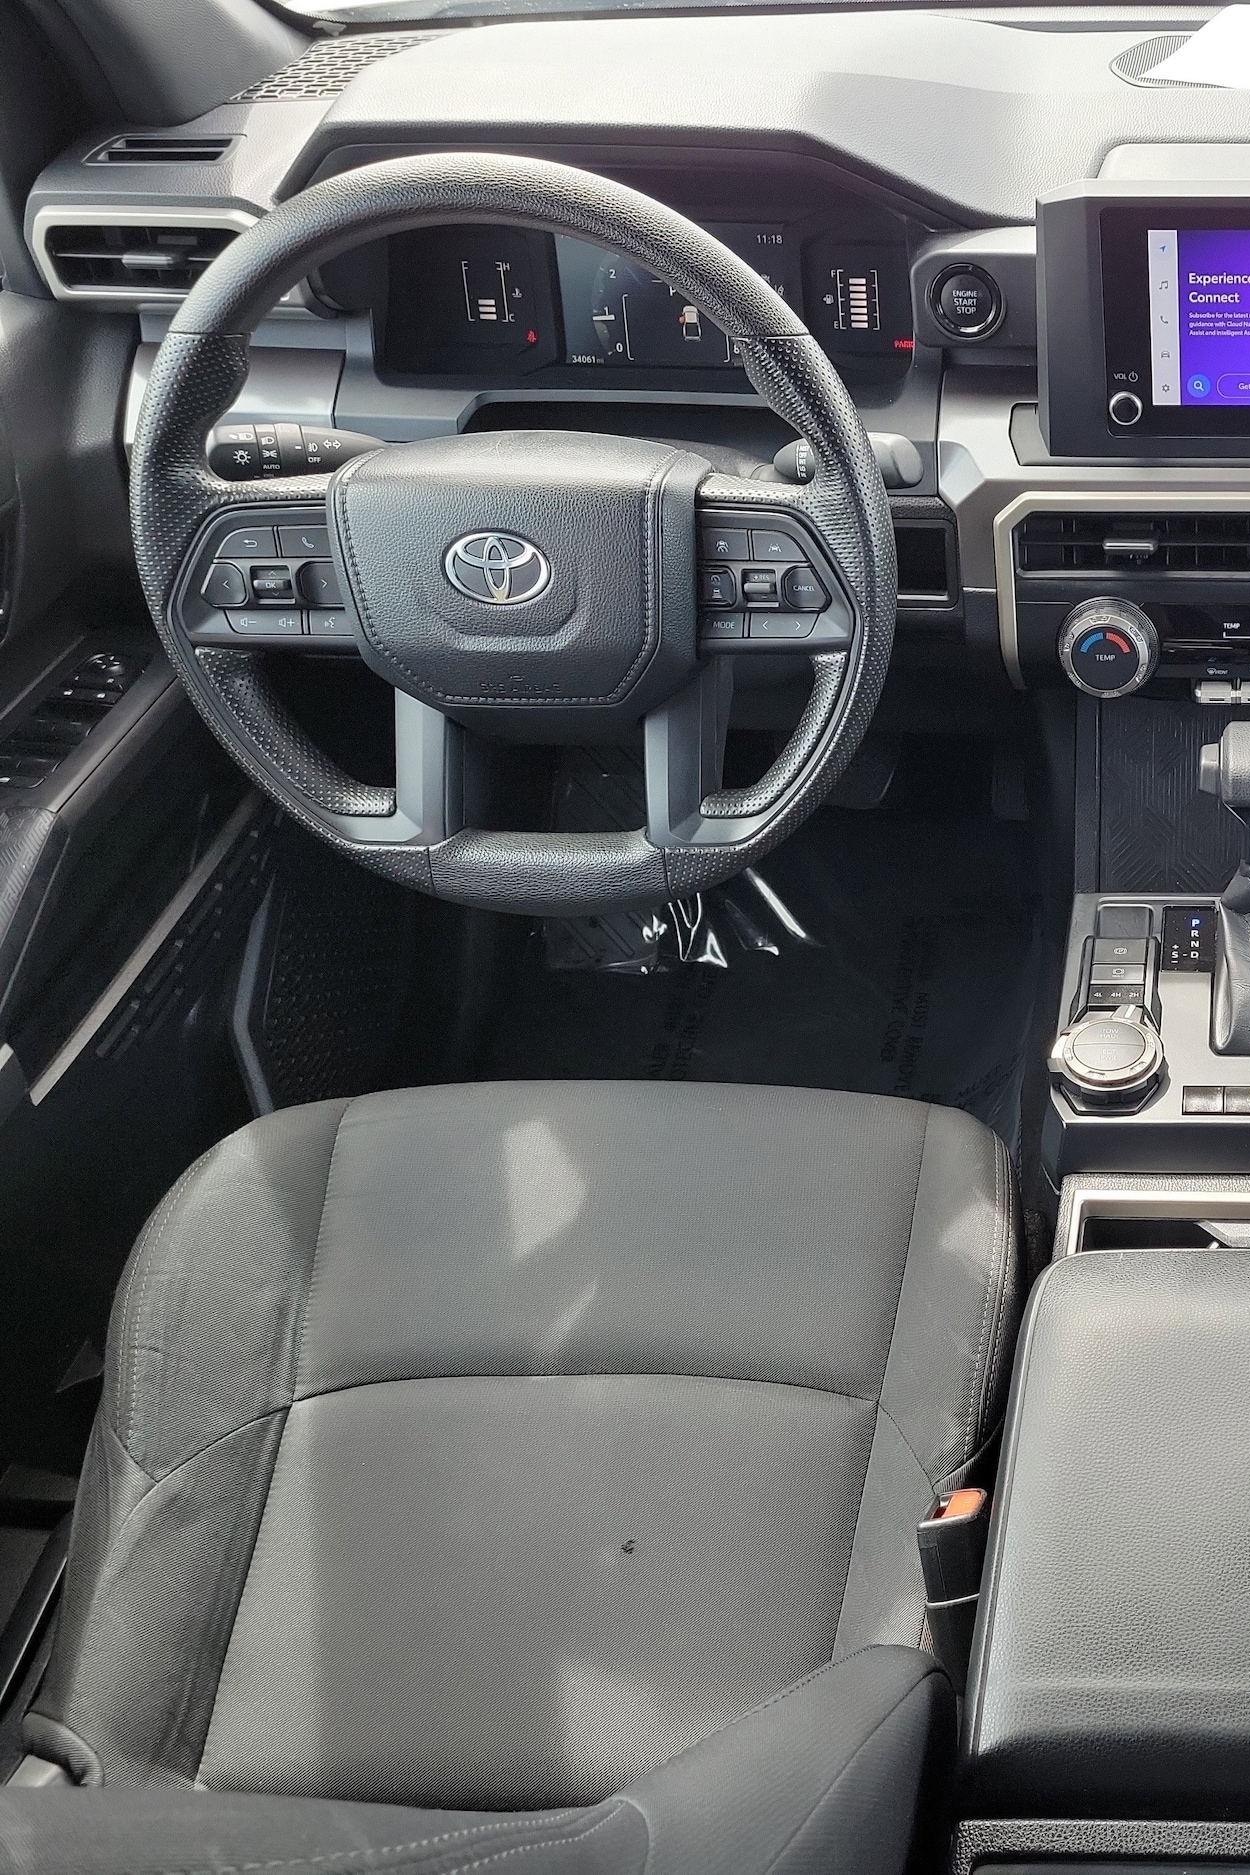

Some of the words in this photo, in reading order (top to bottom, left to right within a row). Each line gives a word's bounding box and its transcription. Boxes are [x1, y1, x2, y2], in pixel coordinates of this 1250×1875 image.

[756, 234, 783, 244] 11:18
[608, 268, 617, 279] 2
[952, 289, 978, 298] ENGINE
[1188, 291, 1240, 303] Connect
[953, 297, 978, 306] START
[956, 306, 977, 315] STOP
[1188, 321, 1214, 329] guidance
[616, 343, 624, 353] 0
[571, 355, 596, 364] 34061
[1113, 372, 1127, 380] VOL
[307, 456, 322, 464] OFF
[793, 584, 816, 592] CANCEL
[712, 621, 736, 630] MODE
[1223, 622, 1241, 630] TEMP
[1095, 653, 1116, 662] TEMP
[1191, 918, 1200, 928] P
[1190, 929, 1200, 938] R
[1190, 940, 1200, 948] N
[1190, 951, 1200, 959] D
